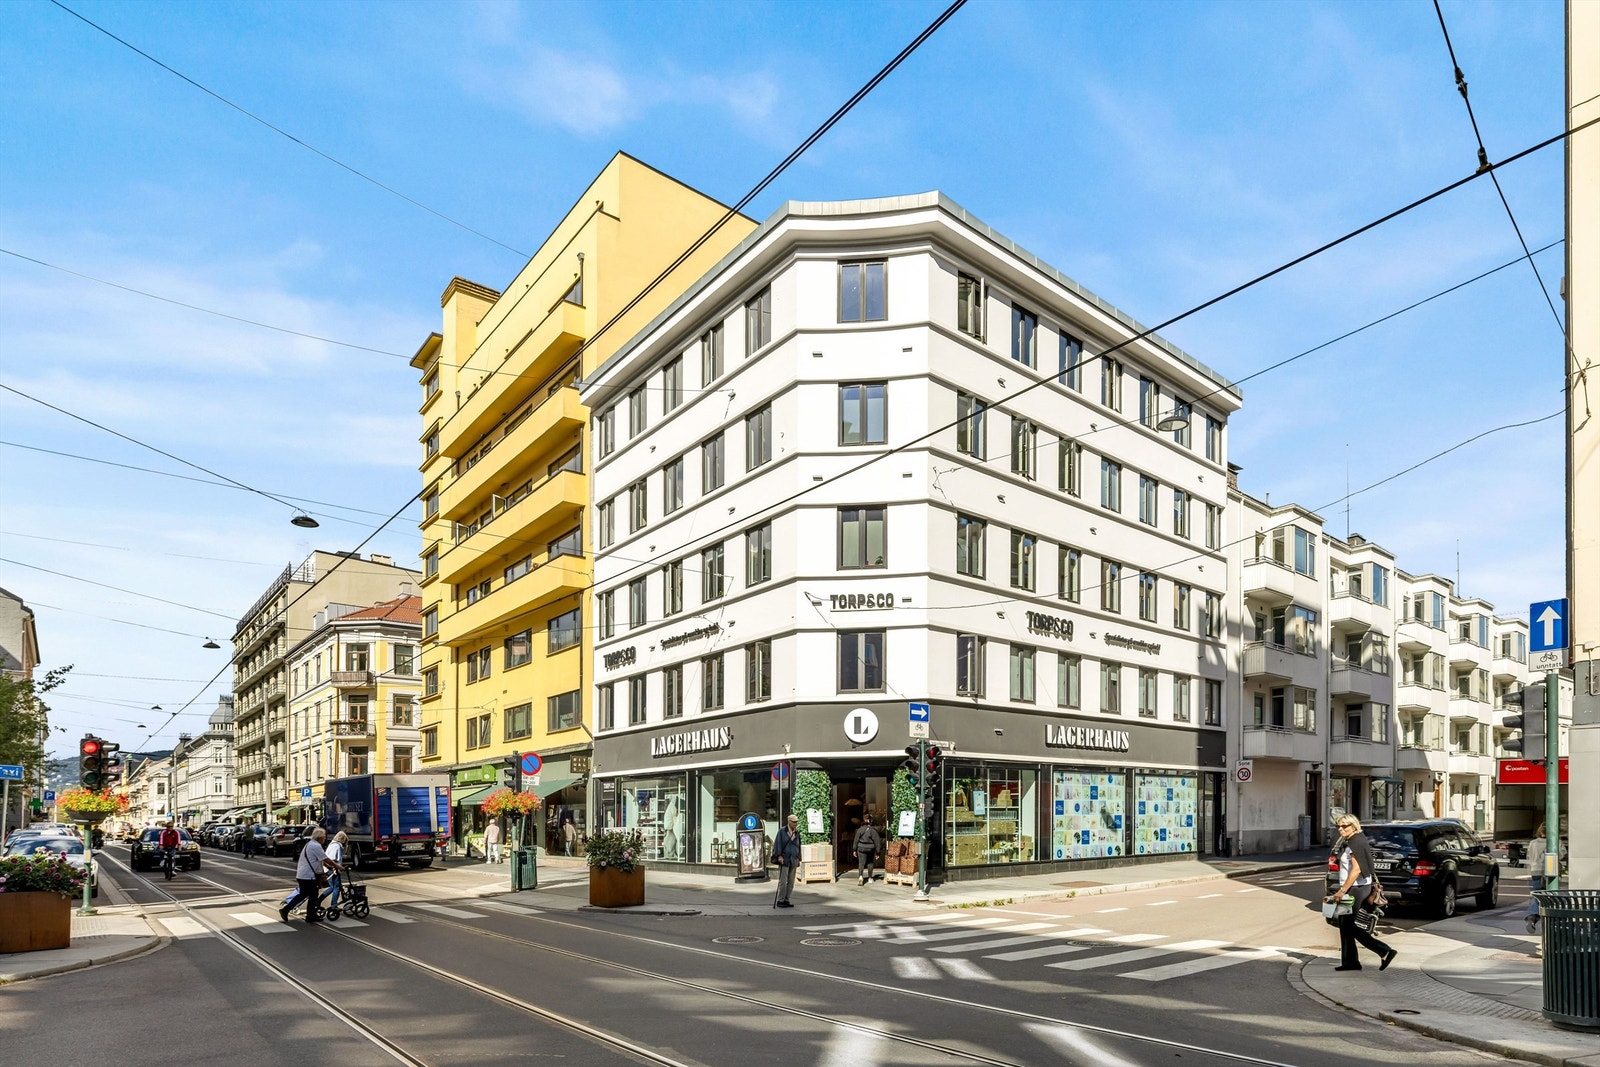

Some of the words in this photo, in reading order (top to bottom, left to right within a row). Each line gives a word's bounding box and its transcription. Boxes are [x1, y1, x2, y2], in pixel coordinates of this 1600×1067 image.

[830, 593, 894, 609] TORP&CO
[1026, 611, 1074, 637] TORP&CO
[603, 646, 637, 669] TORP&CO
[854, 716, 868, 734] L
[651, 727, 731, 756] LAGERHAUS
[1045, 724, 1130, 751] LAGERHAUS
[1240, 770, 1249, 778] 30
[46, 791, 53, 799] P
[303, 788, 310, 796] P
